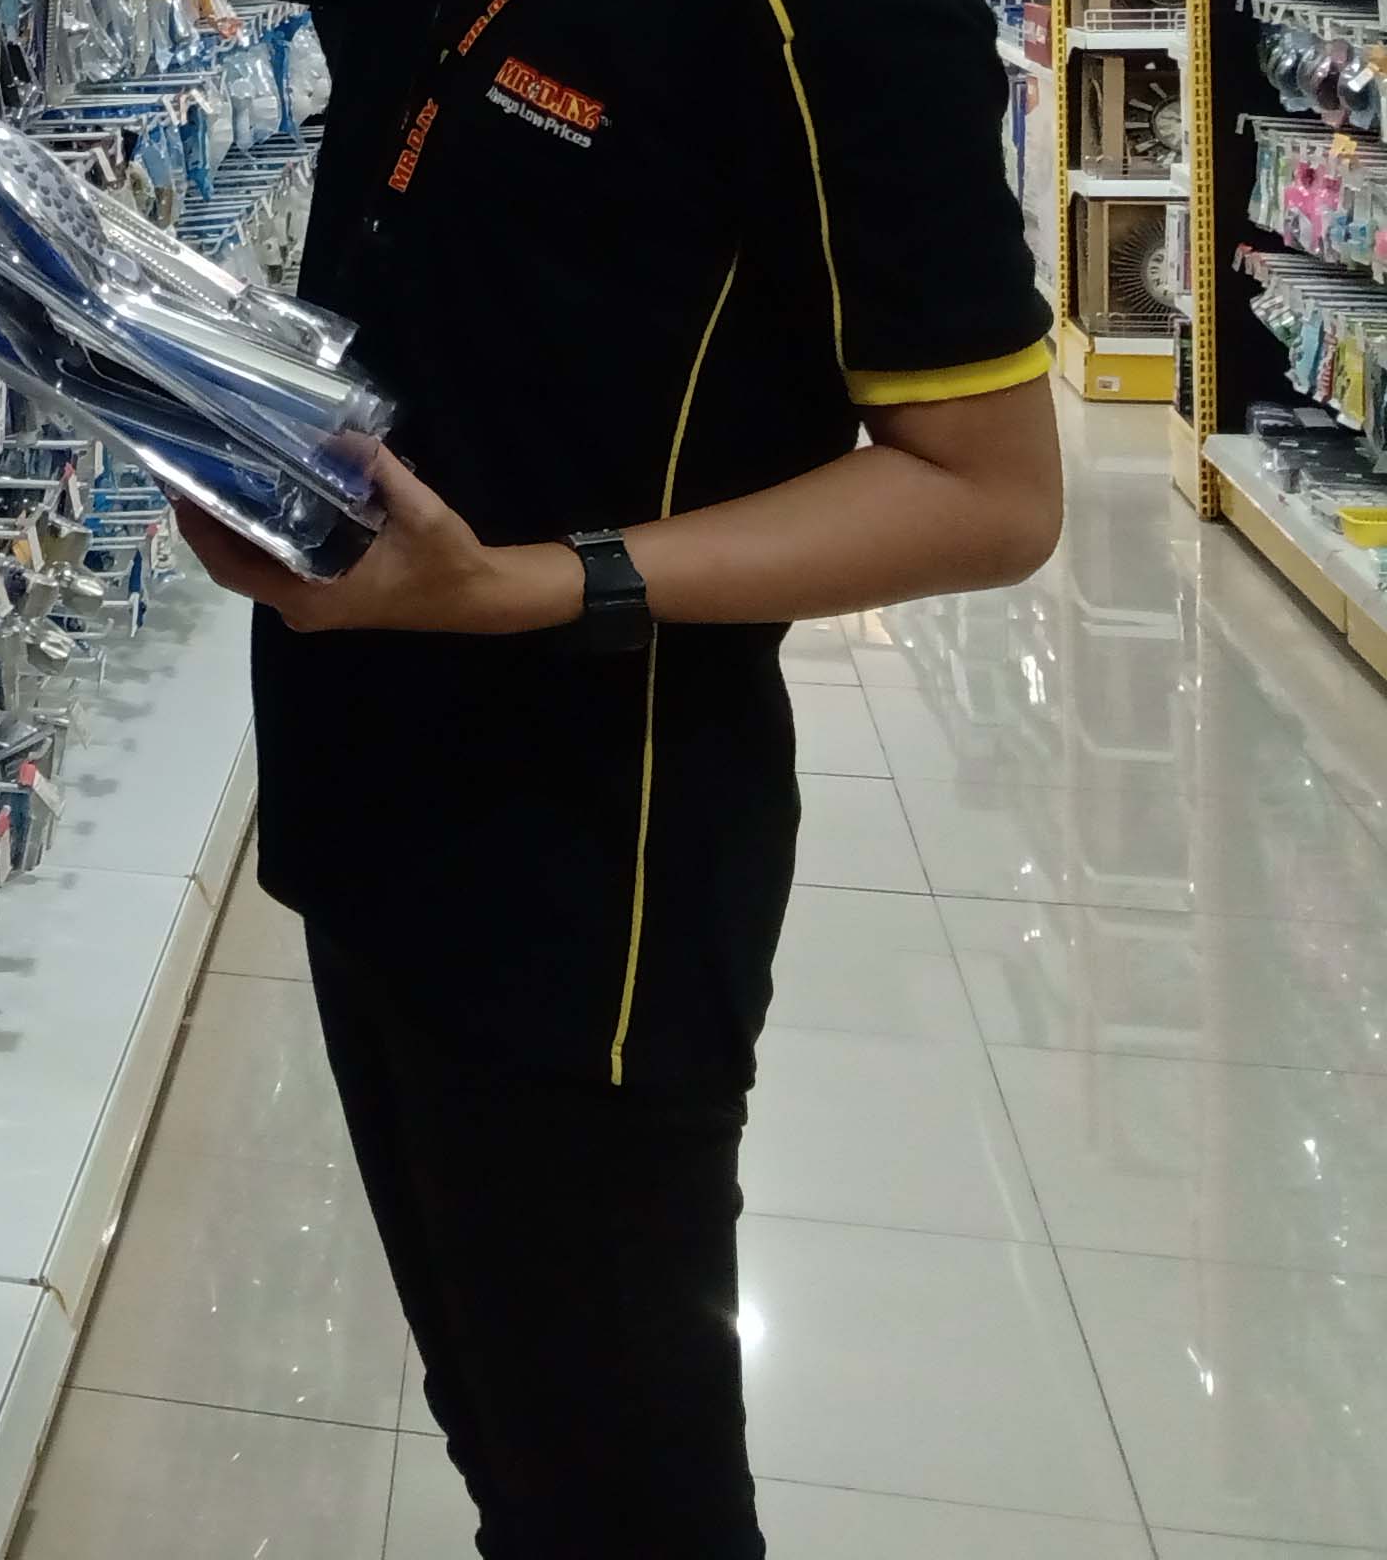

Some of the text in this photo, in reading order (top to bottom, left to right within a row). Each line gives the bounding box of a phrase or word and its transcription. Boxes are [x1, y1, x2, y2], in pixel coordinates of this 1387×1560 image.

[485, 84, 592, 149] Always Low Prices
